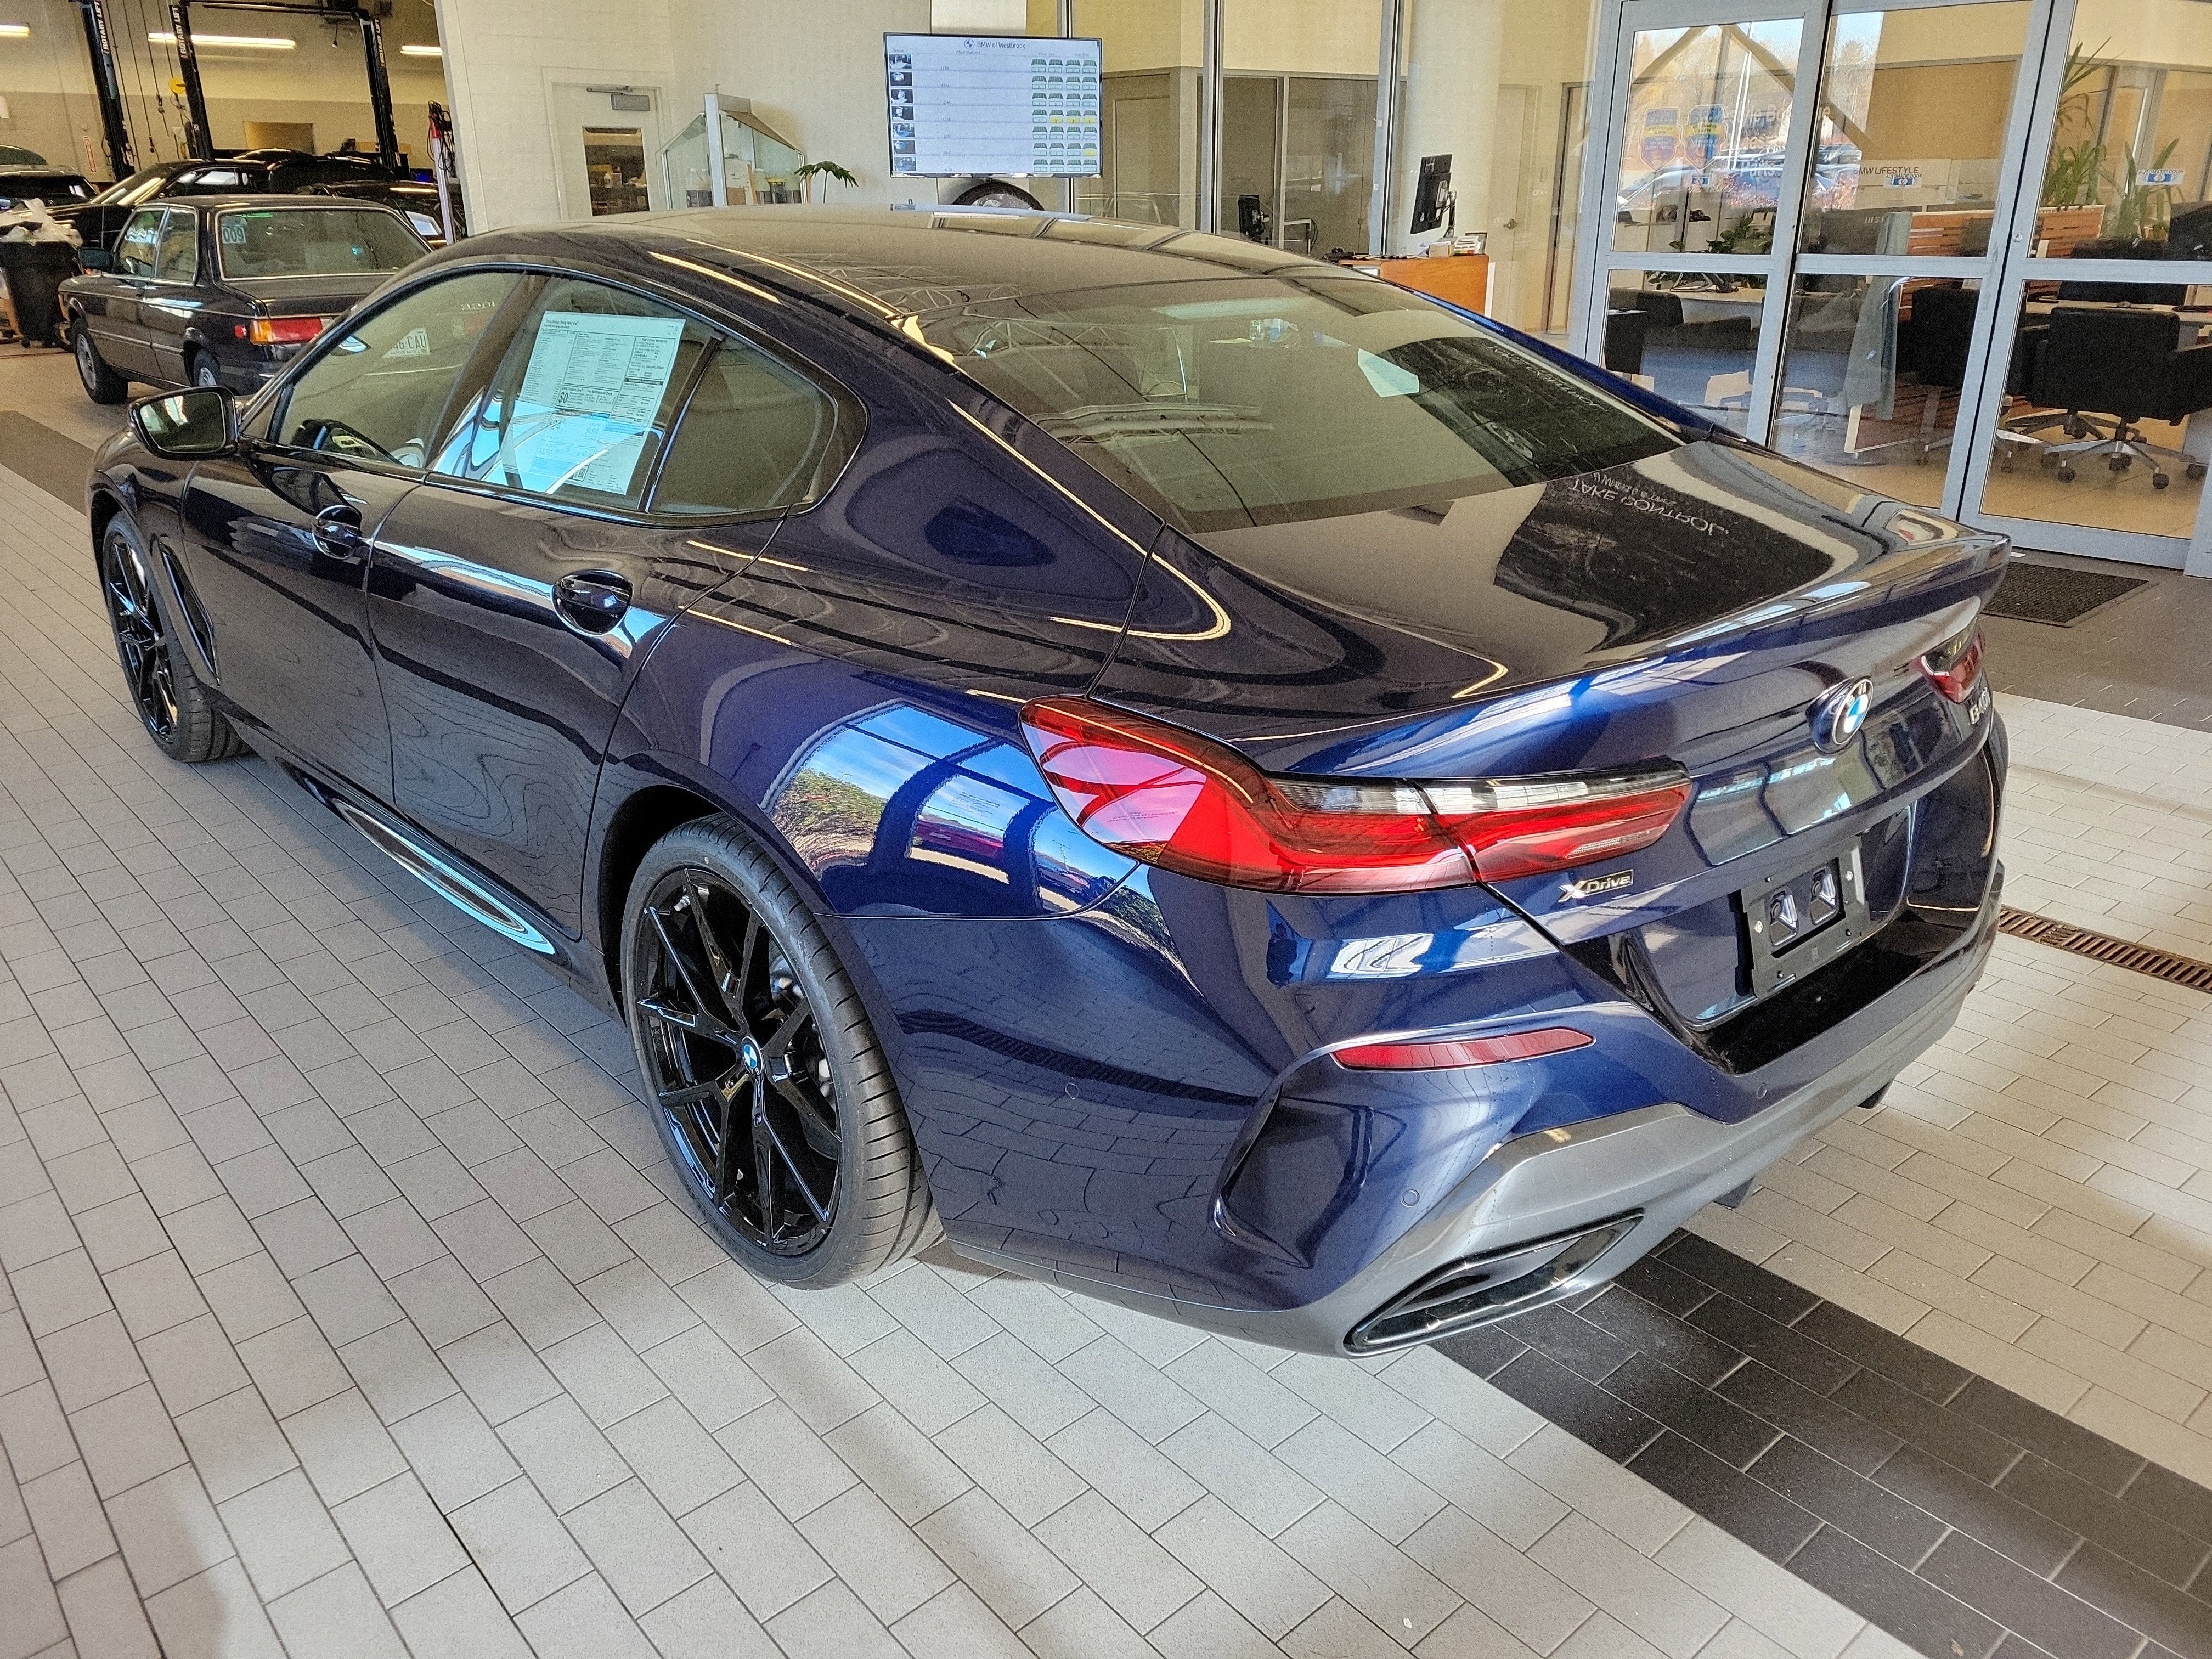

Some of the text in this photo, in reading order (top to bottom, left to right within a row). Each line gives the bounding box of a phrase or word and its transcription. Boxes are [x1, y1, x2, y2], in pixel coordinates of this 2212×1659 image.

[94, 1, 109, 50] ROTARY LIFT
[172, 6, 187, 55] ROTARY LIFT
[1875, 166, 1919, 174] LIFESTYLE
